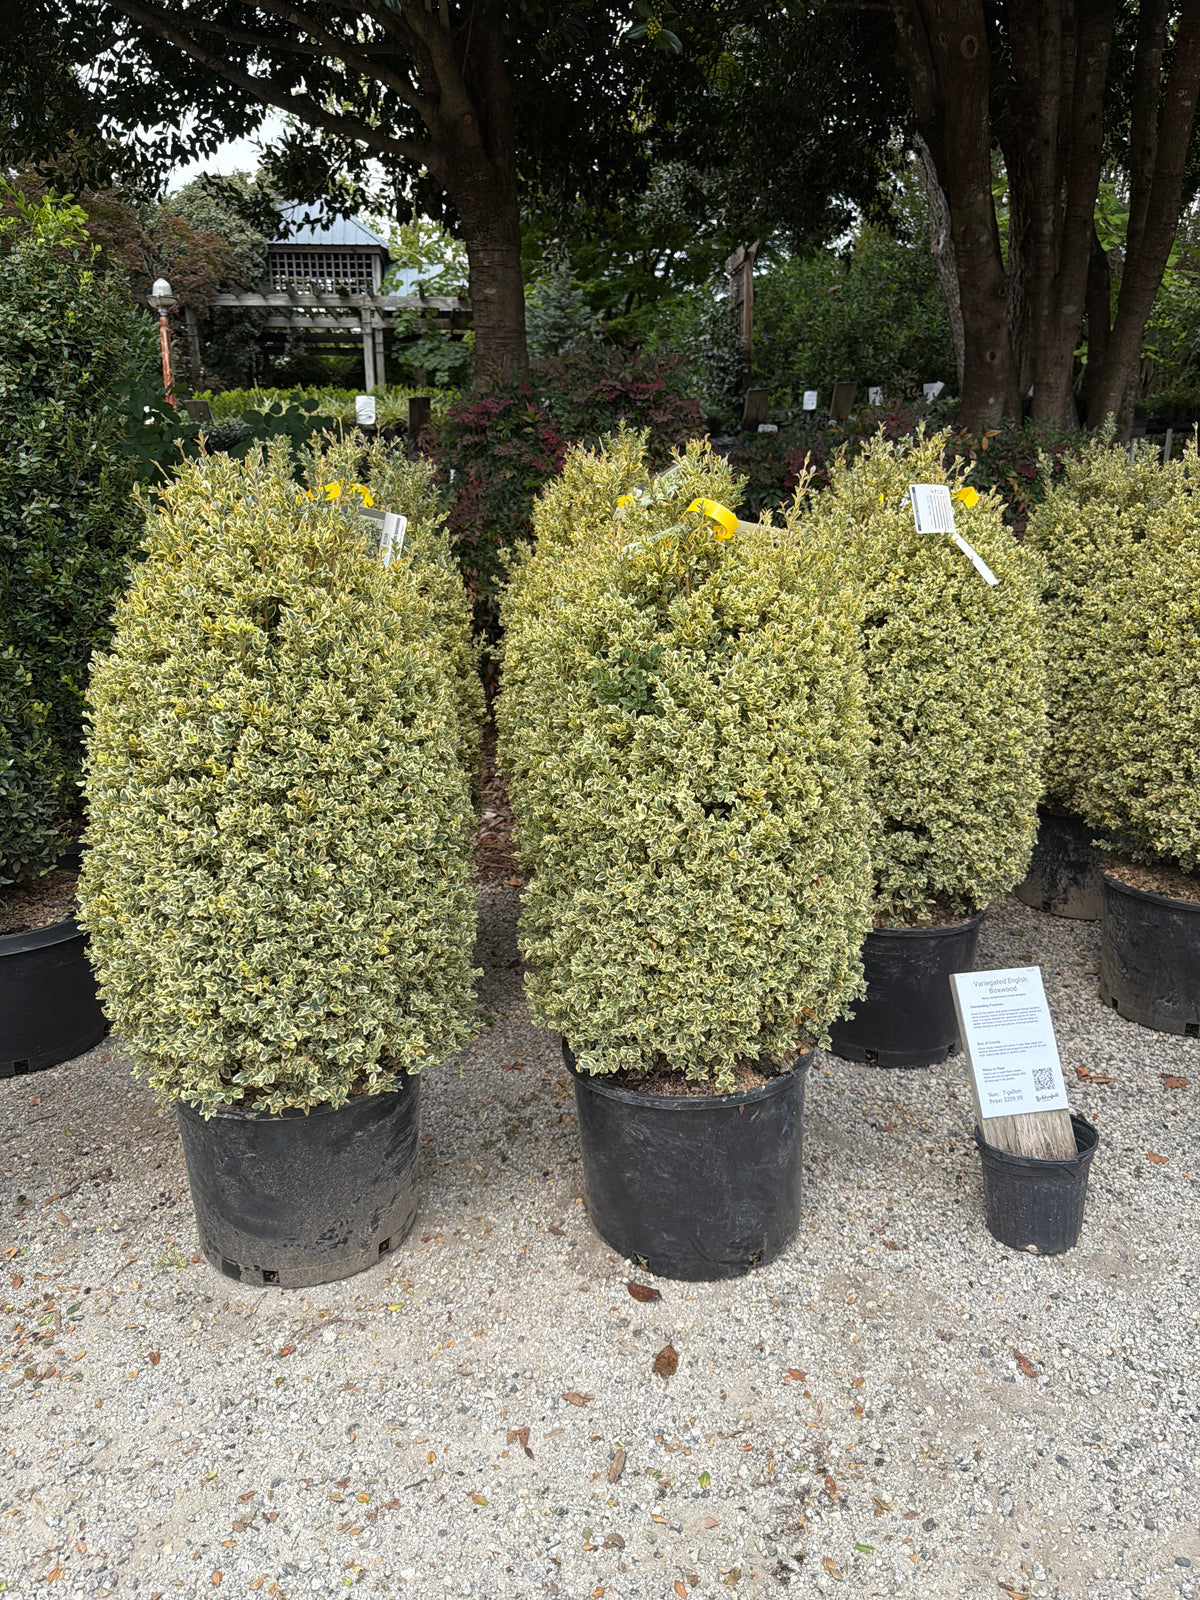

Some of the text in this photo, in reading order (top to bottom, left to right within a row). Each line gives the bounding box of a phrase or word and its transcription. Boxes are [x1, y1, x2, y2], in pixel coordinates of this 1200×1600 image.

[973, 976, 1028, 987] Variegated English
[989, 985, 1018, 994] Boxwood
